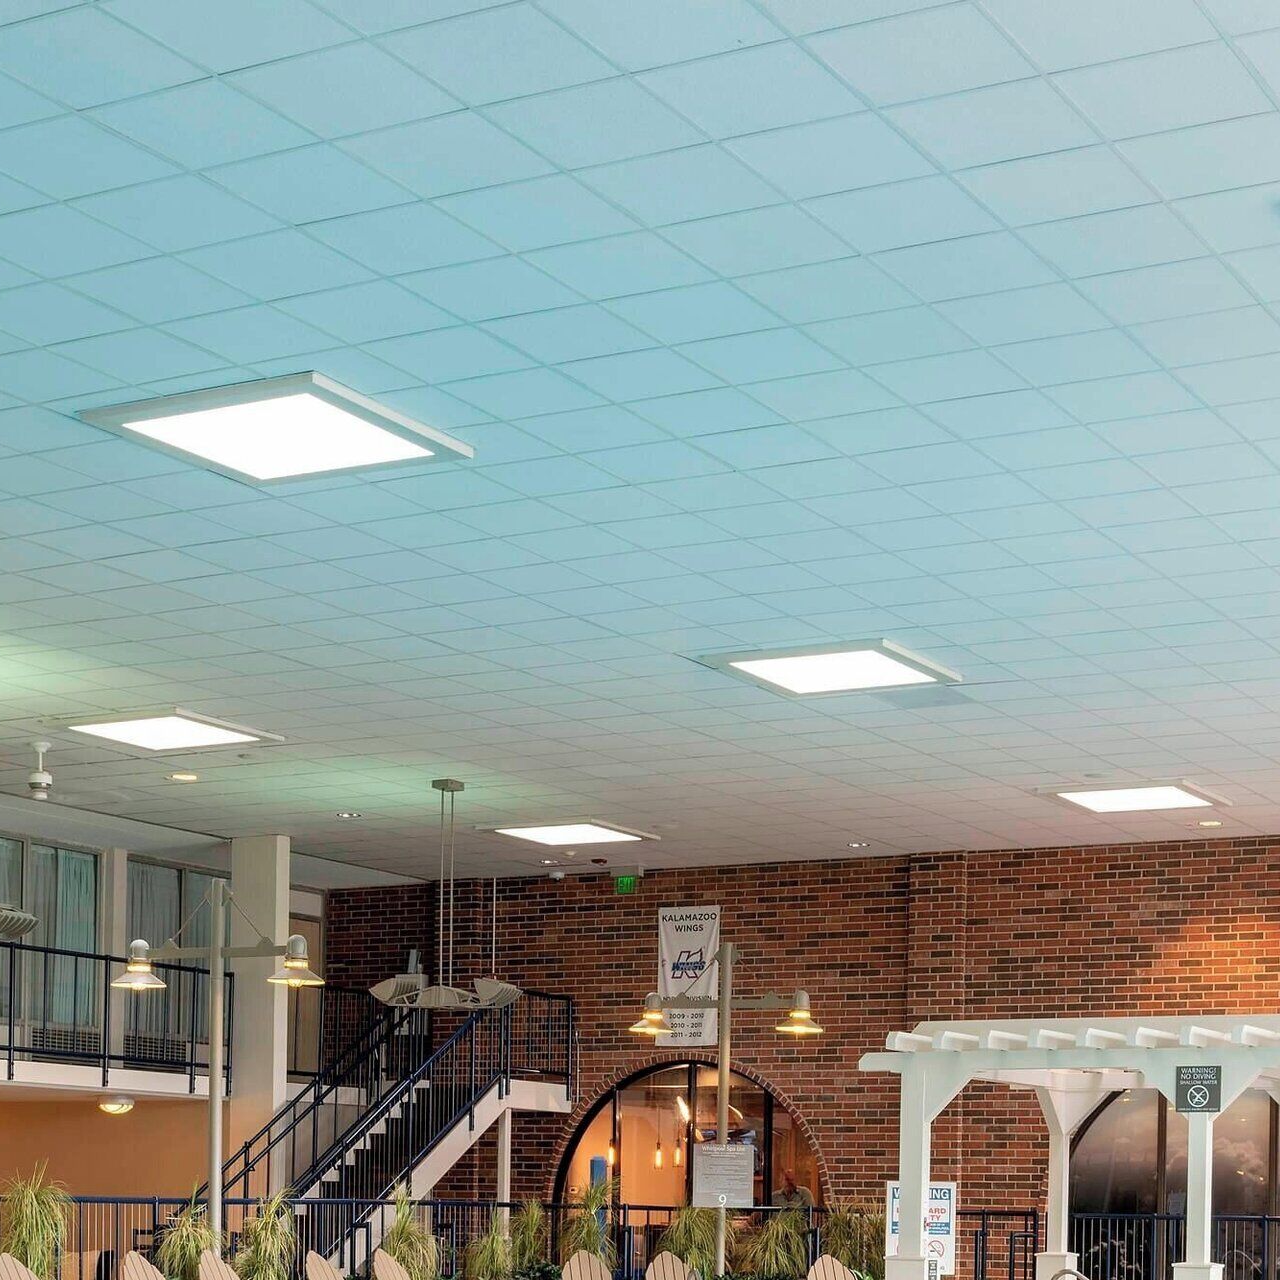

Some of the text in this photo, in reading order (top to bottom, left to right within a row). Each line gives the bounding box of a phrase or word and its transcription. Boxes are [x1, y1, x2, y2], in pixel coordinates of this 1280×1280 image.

[618, 877, 634, 893] EXIT
[661, 912, 717, 922] KALAMAZOO
[674, 924, 704, 932] WINGS
[671, 960, 706, 972] WINGS
